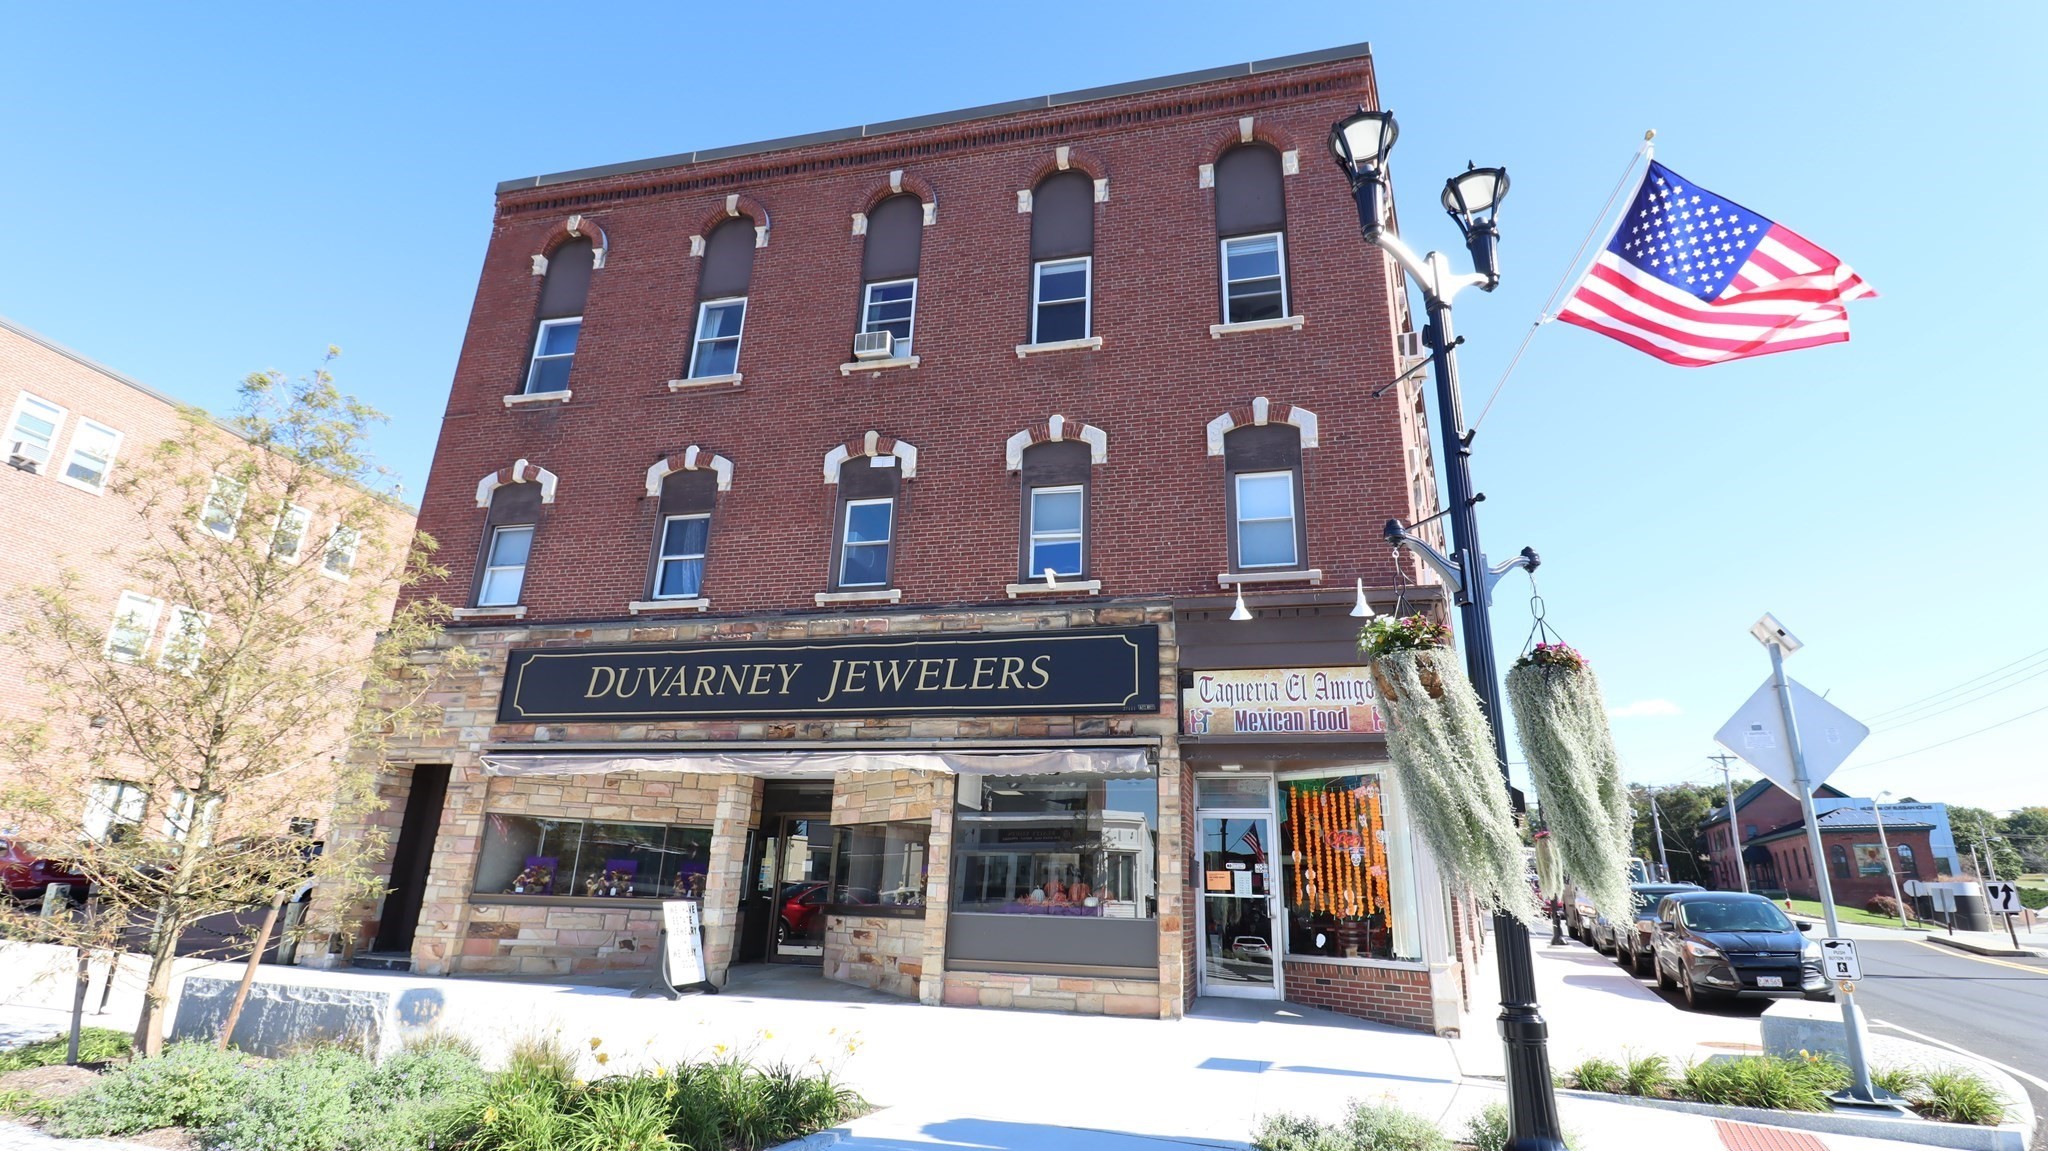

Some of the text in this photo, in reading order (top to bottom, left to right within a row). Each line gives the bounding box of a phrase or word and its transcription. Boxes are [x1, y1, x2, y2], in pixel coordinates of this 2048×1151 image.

[584, 655, 1050, 703] DUVARNEY JEWELERS
[1199, 671, 1375, 707] Taqueria El Amigo
[1234, 707, 1348, 732] Mexican Food
